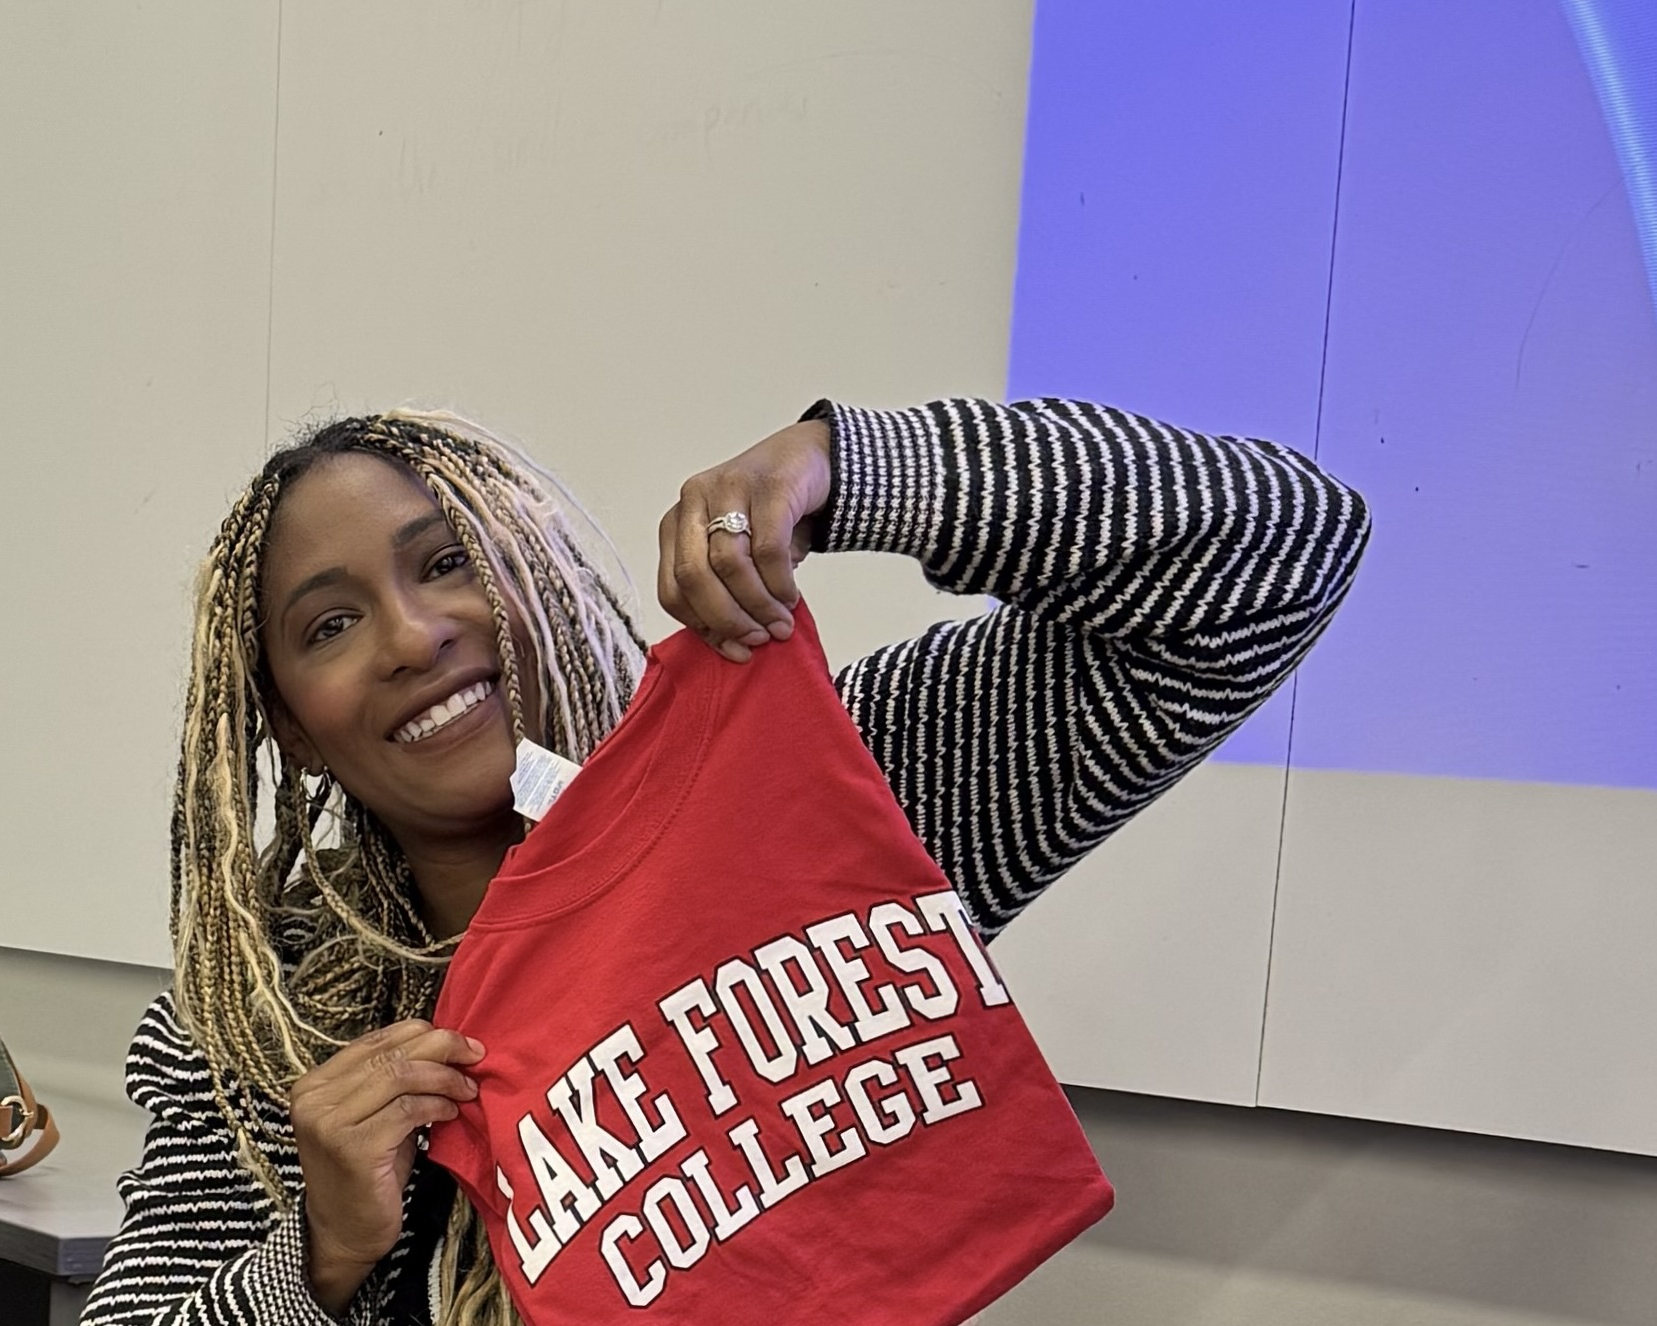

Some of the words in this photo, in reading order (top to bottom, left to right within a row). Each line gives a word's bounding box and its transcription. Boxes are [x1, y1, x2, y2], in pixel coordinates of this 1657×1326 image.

[497, 1023, 689, 1286] LAKE
[658, 890, 1010, 1118] FOREST
[600, 1034, 983, 1308] COLLEGE
